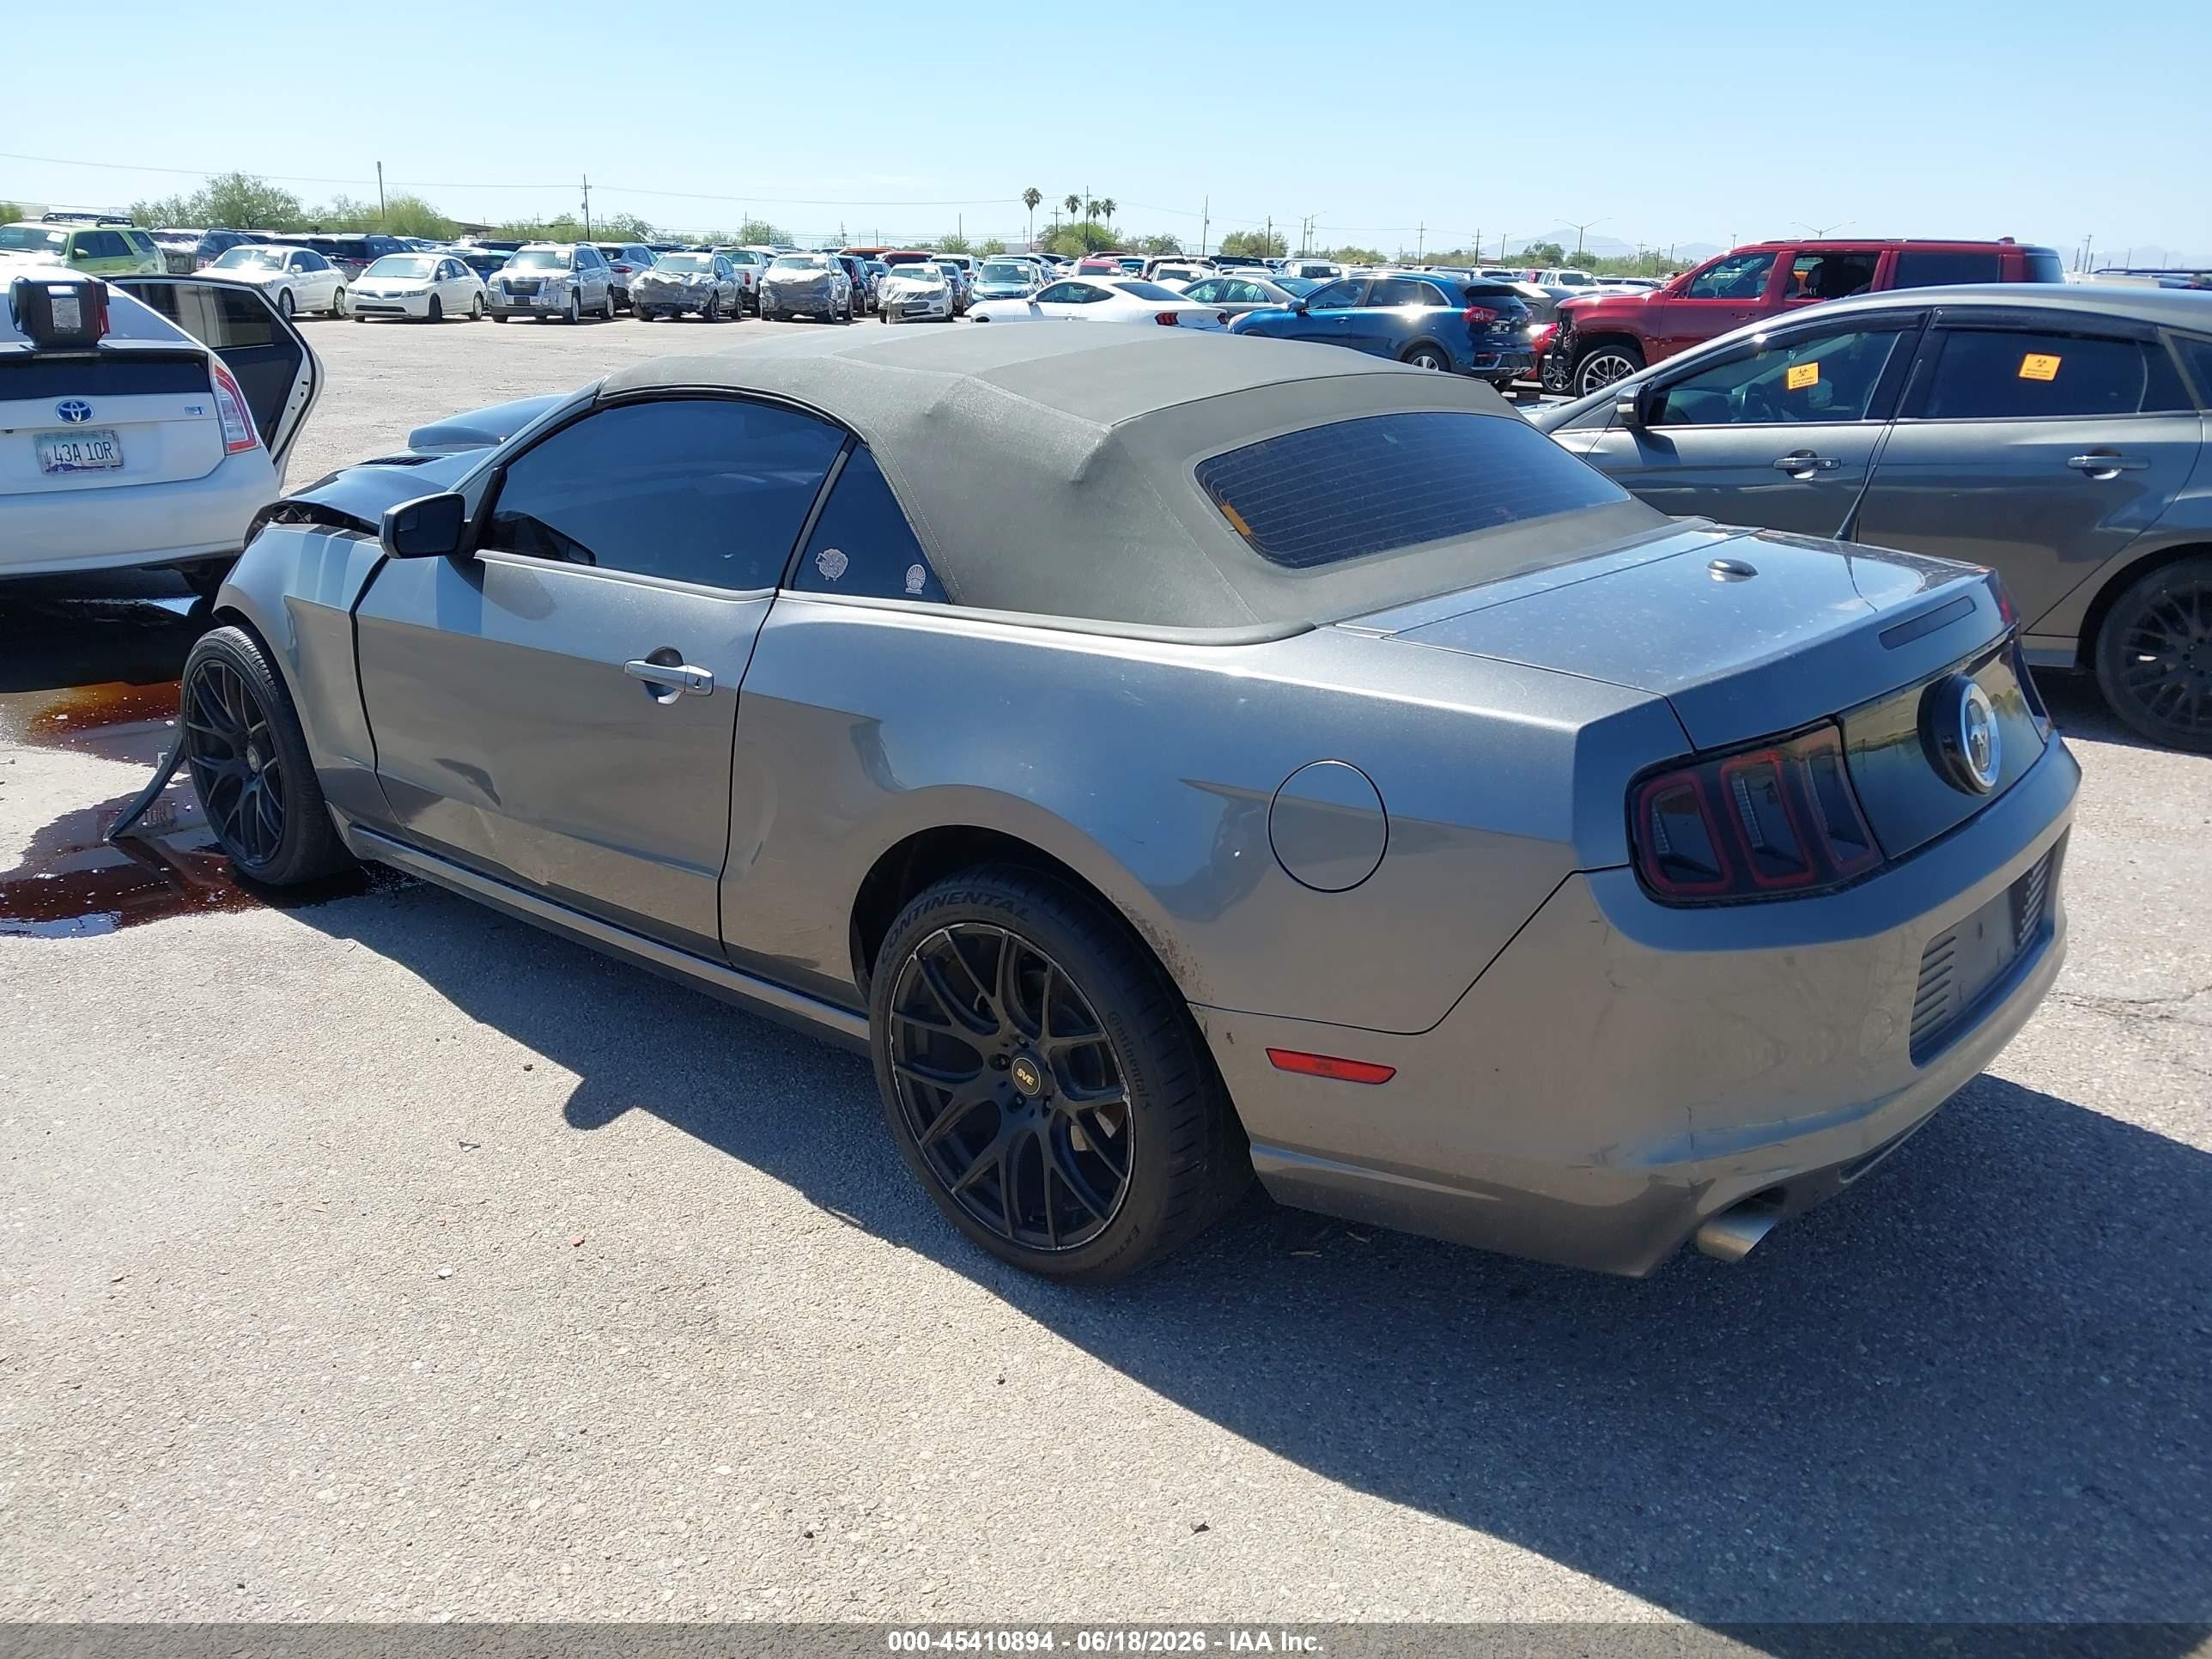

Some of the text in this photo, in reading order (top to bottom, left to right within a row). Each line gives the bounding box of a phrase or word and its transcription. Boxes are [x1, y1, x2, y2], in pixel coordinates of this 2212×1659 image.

[53, 443, 82, 462] 43A
[880, 890, 1030, 959] CONTINENTAL
[1016, 1068, 1036, 1086] SVE
